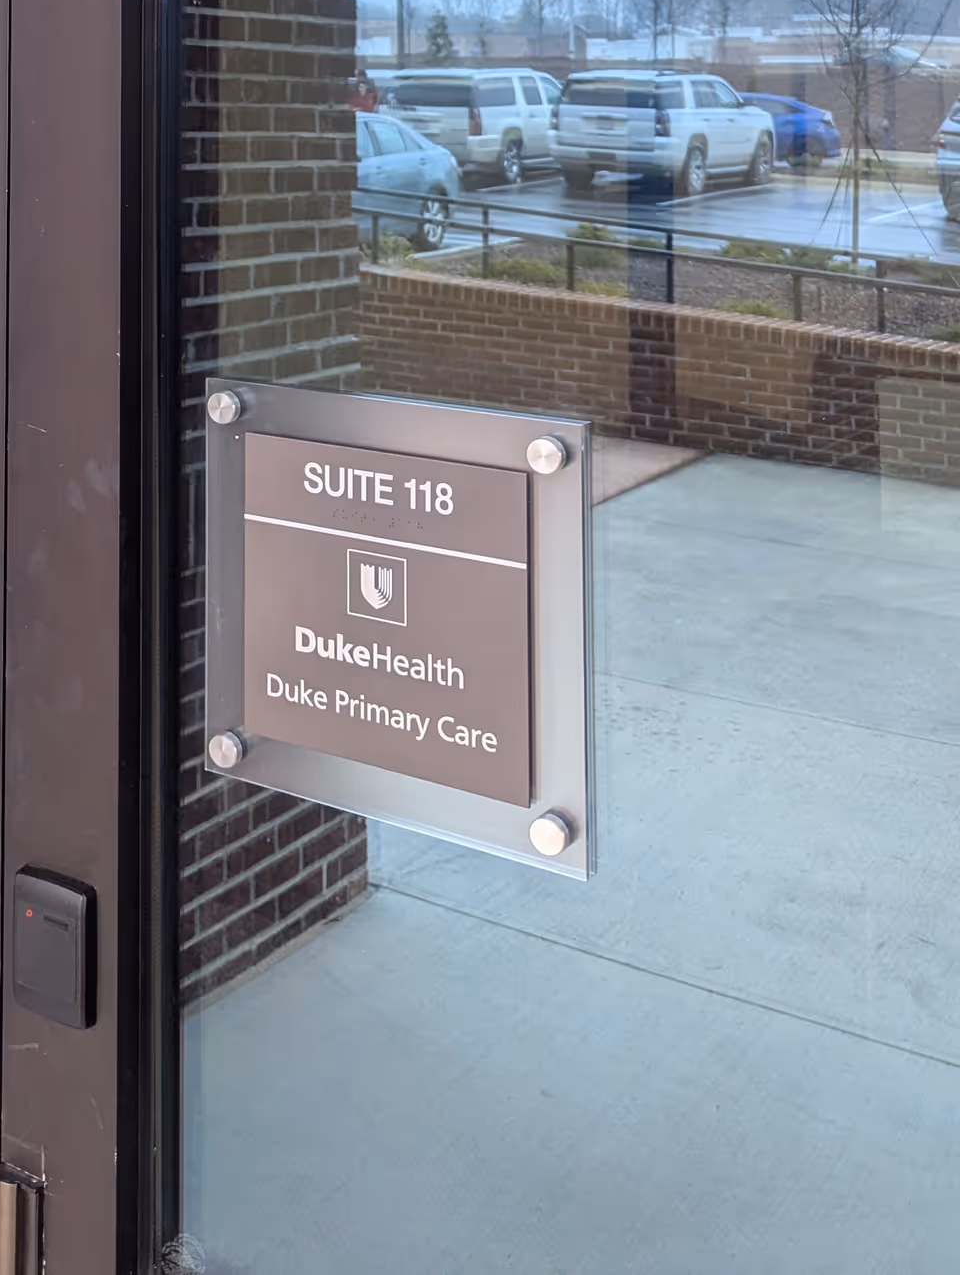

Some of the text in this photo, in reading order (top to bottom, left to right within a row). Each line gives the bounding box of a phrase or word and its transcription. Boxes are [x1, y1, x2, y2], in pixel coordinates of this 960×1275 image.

[302, 461, 454, 516] SUITE 118
[294, 624, 465, 690] DukeHealth
[266, 671, 499, 754] Duke Primary Care
